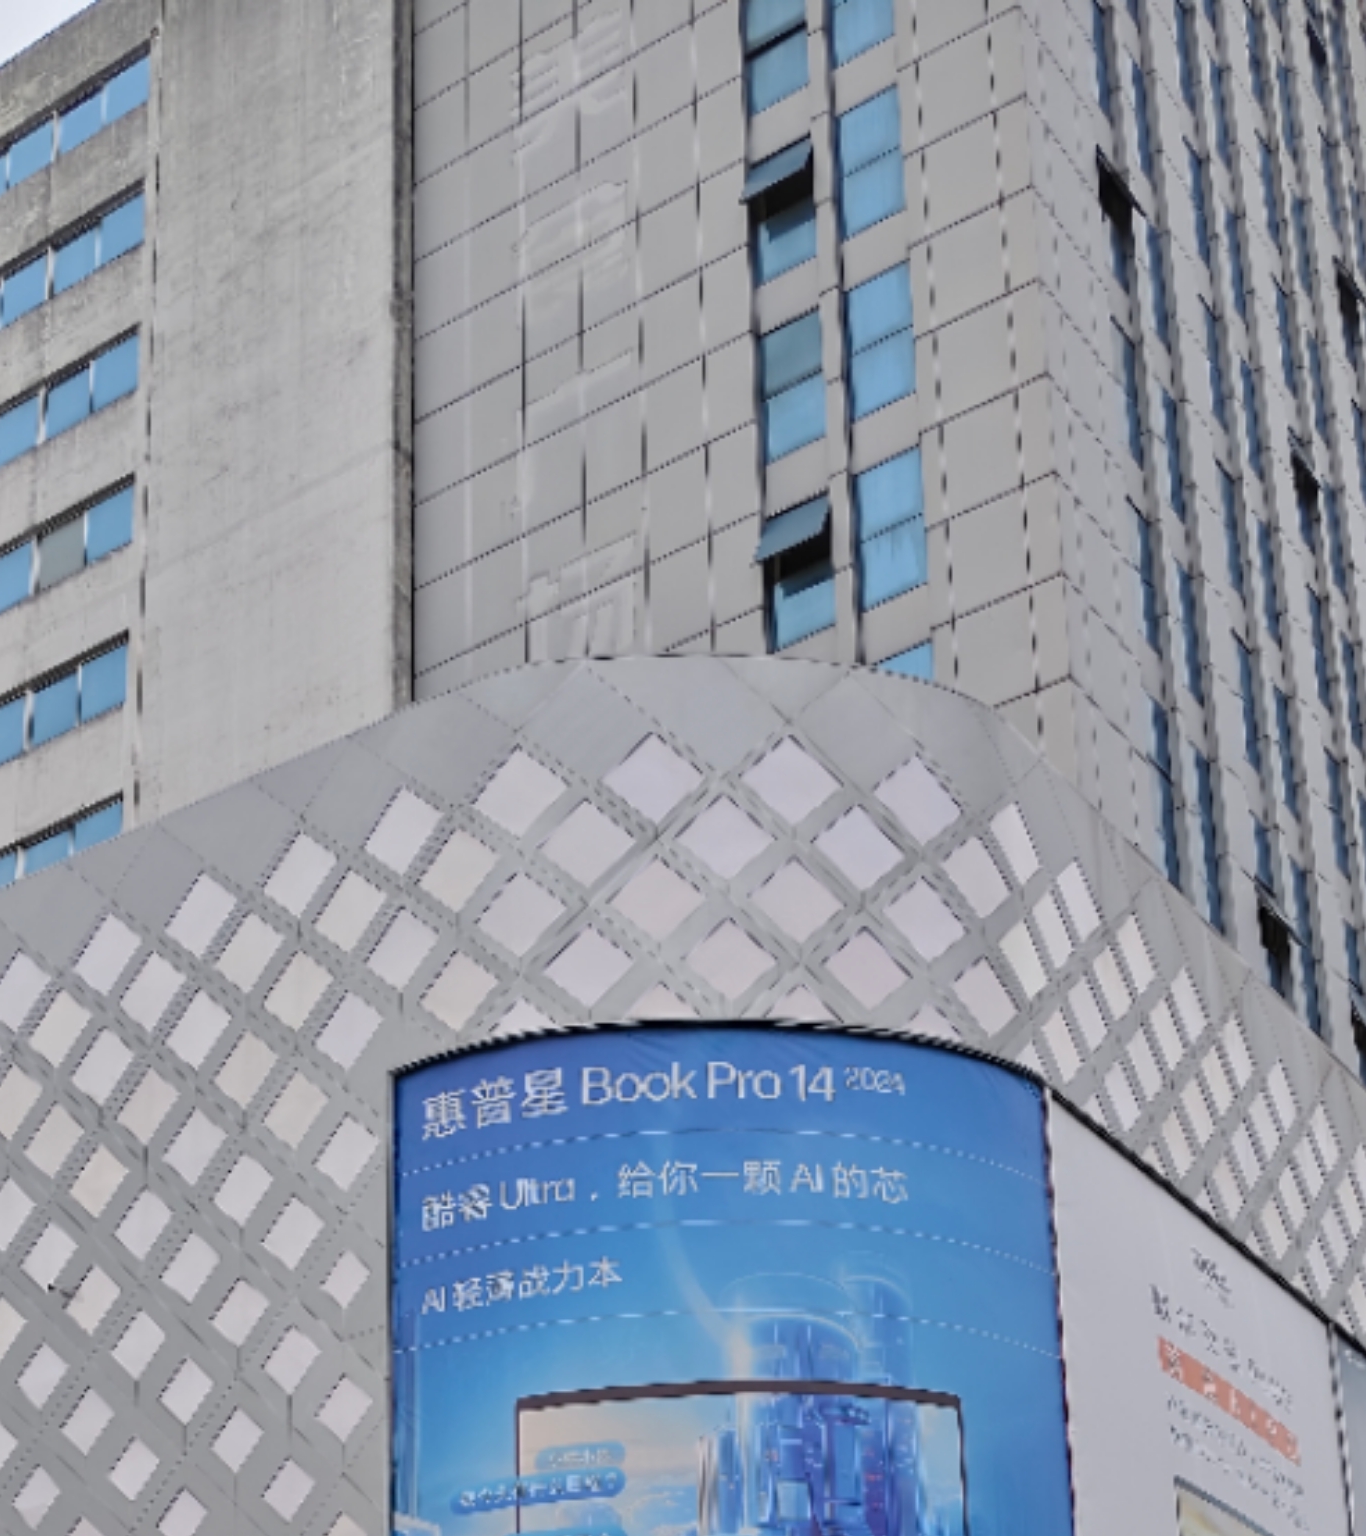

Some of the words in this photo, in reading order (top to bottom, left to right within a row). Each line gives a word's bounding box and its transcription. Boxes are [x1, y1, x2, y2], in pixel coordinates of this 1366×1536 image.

[421, 1067, 568, 1140] 惠普星
[581, 1062, 698, 1105] Book
[706, 1062, 781, 1099] Pro
[790, 1066, 836, 1101] 14
[421, 1182, 493, 1232] 酷睿
[617, 1160, 781, 1198] 给你一颗
[791, 1163, 824, 1193] AI
[832, 1161, 910, 1204] 的芯
